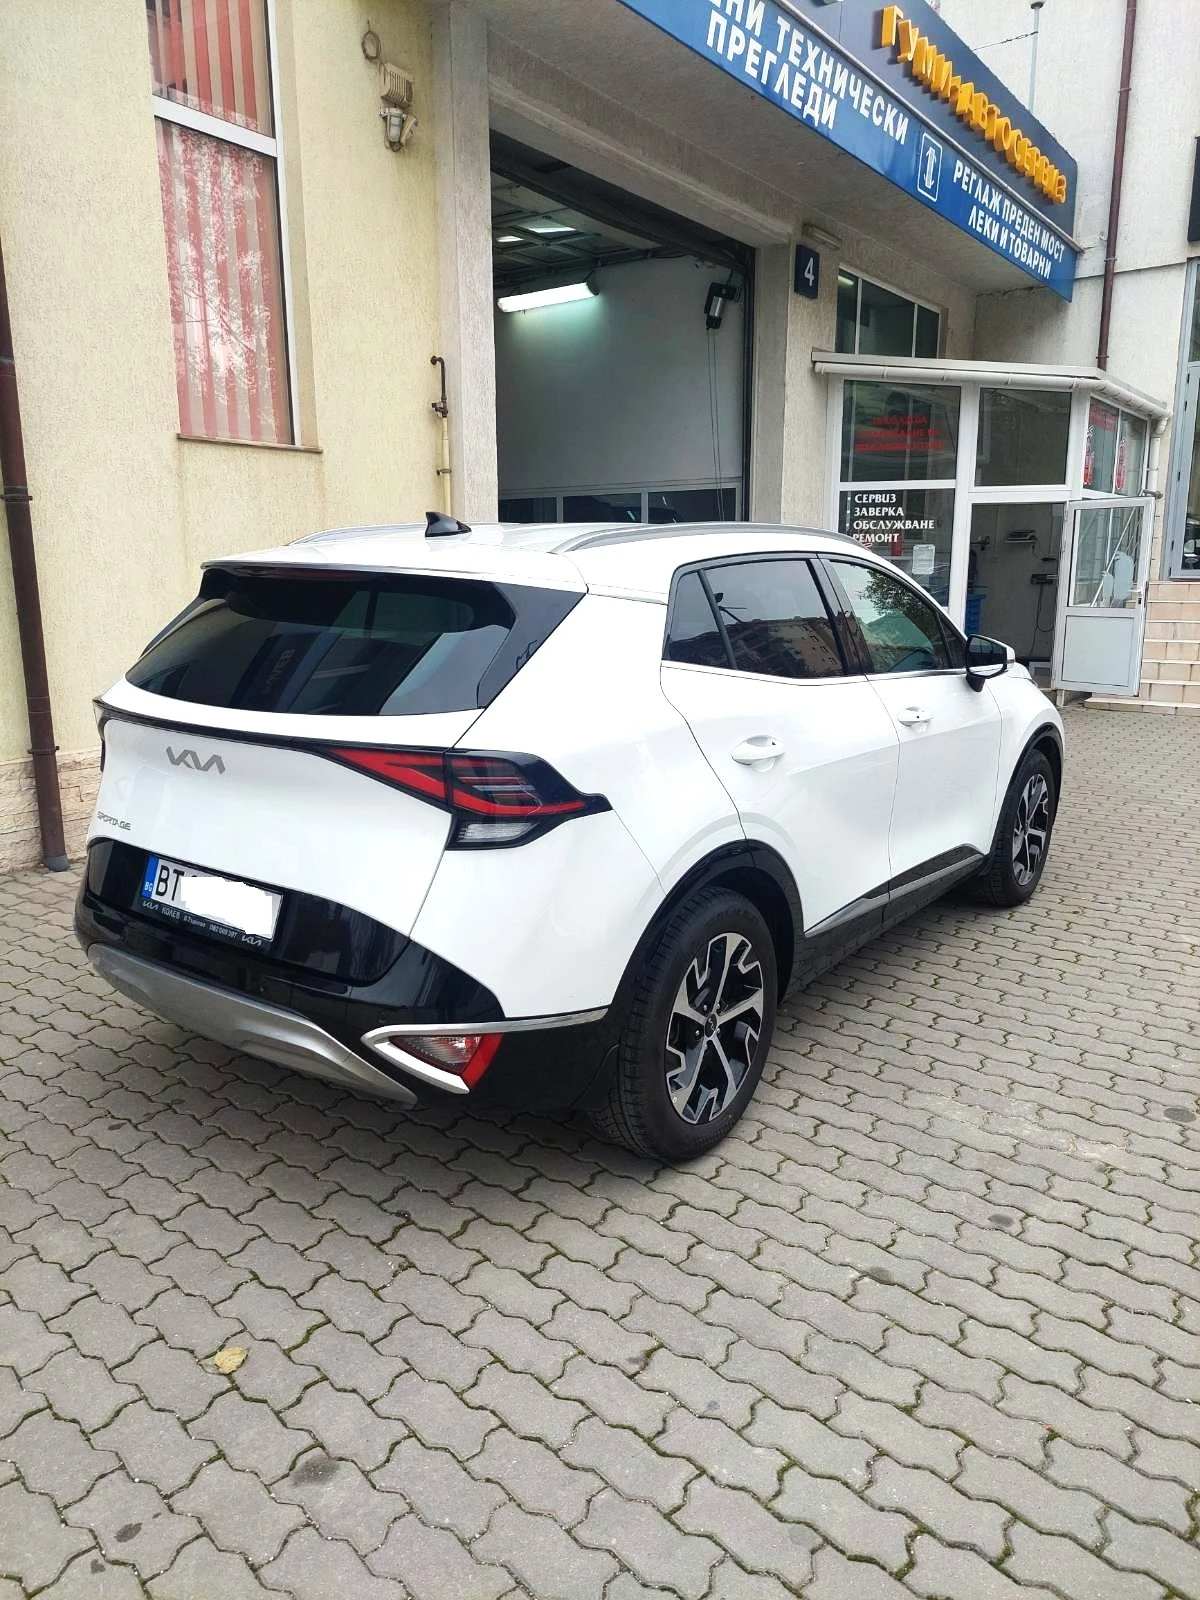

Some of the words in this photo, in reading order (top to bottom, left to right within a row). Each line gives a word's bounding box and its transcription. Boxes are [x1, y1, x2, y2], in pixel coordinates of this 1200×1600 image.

[706, 9, 838, 130] ПРЕГЛЕДИ
[776, 15, 909, 145] ТЕХНИЧЕСКИ
[953, 160, 1002, 216] РЕГЛАЖ
[1002, 199, 1041, 245] ПРЕДЕН
[1040, 231, 1065, 263] МОСТ
[968, 205, 1000, 245] ЛЕКИ
[1000, 226, 1009, 249] И
[1009, 233, 1052, 280] ТОВАРНИ
[804, 257, 815, 287] 4
[854, 493, 897, 503] СЕРВИЗ
[853, 507, 905, 517] ЗАВЕРКА
[852, 520, 935, 530] ОБСЛУЖВАНЕ
[852, 533, 900, 543] РЕМОНТ
[144, 881, 154, 892] BG
